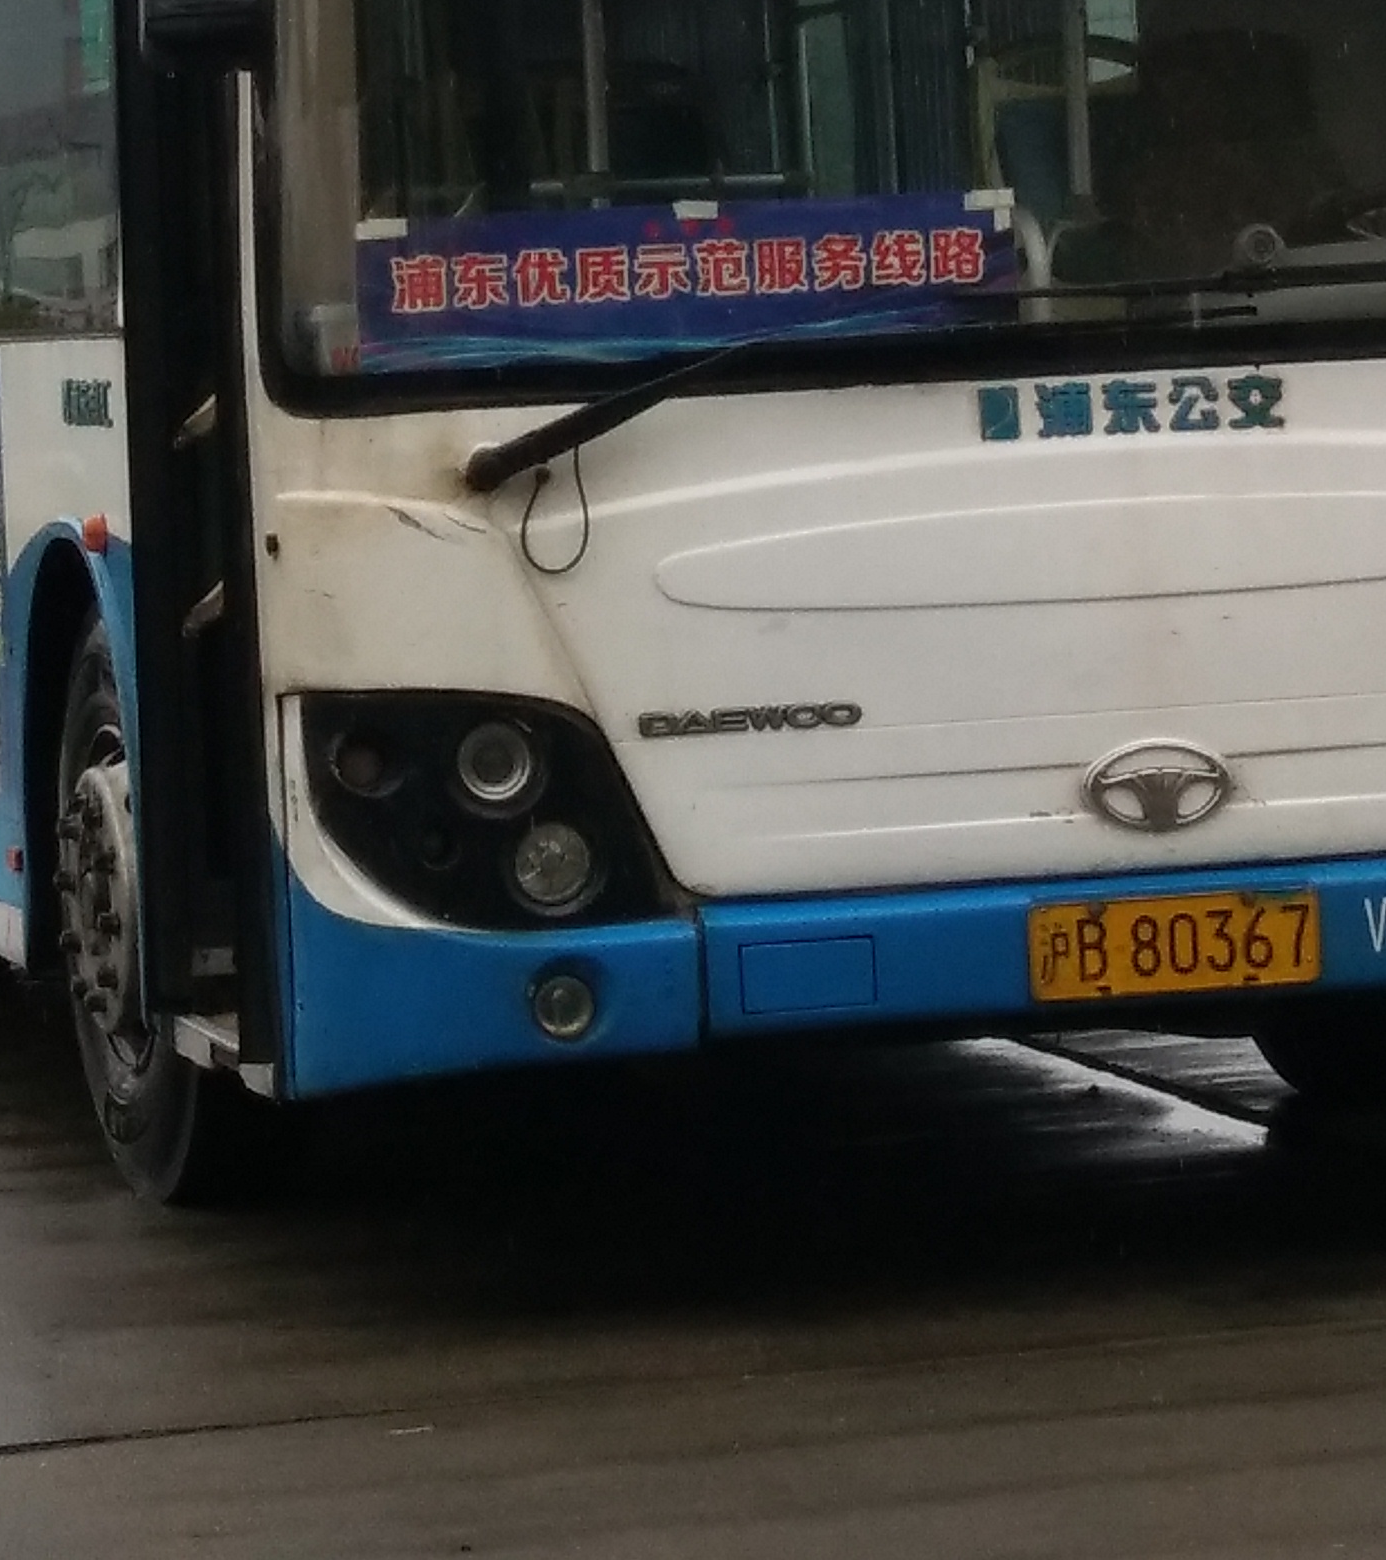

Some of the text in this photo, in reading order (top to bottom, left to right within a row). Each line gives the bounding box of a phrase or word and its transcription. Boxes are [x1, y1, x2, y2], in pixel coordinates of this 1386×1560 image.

[391, 228, 985, 313] 浦东优质示范服务线路
[1035, 375, 1285, 438] 浦东公交
[638, 700, 863, 738] DAEWOO
